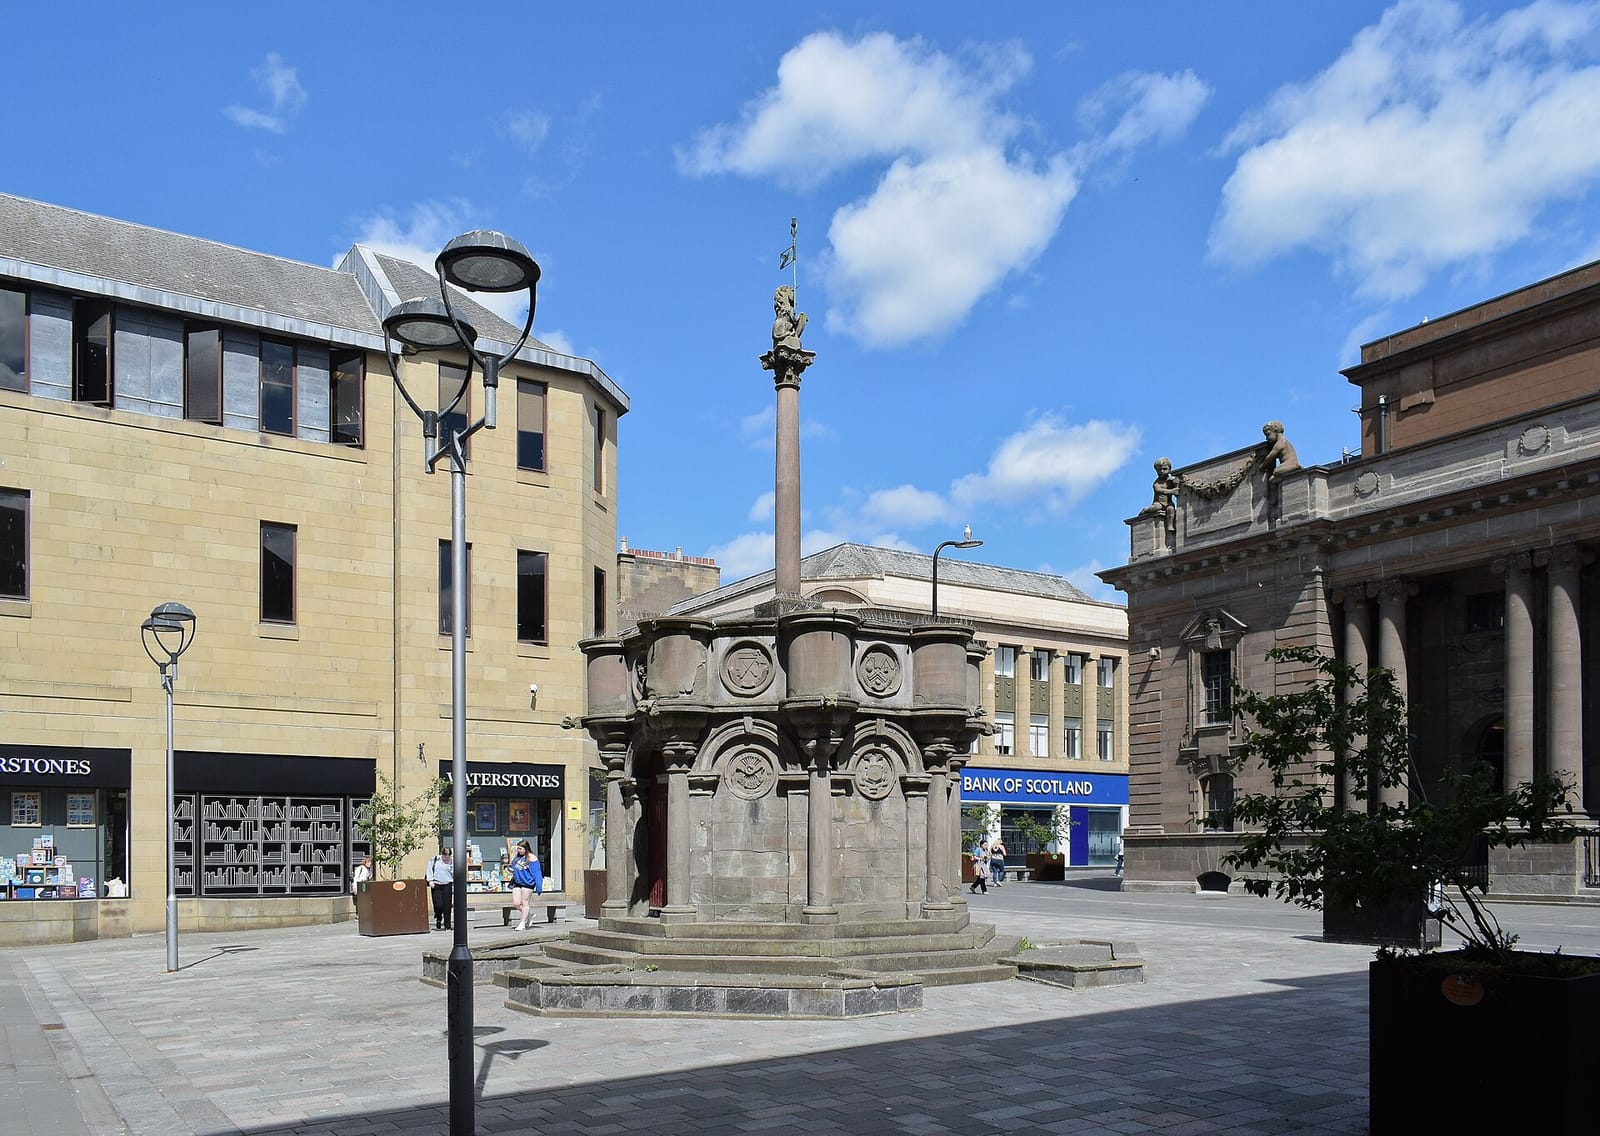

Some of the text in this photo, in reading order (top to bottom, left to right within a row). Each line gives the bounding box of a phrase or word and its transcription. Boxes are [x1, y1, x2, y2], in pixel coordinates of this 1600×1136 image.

[963, 776, 1093, 796] BANK OF SCOTLAND
